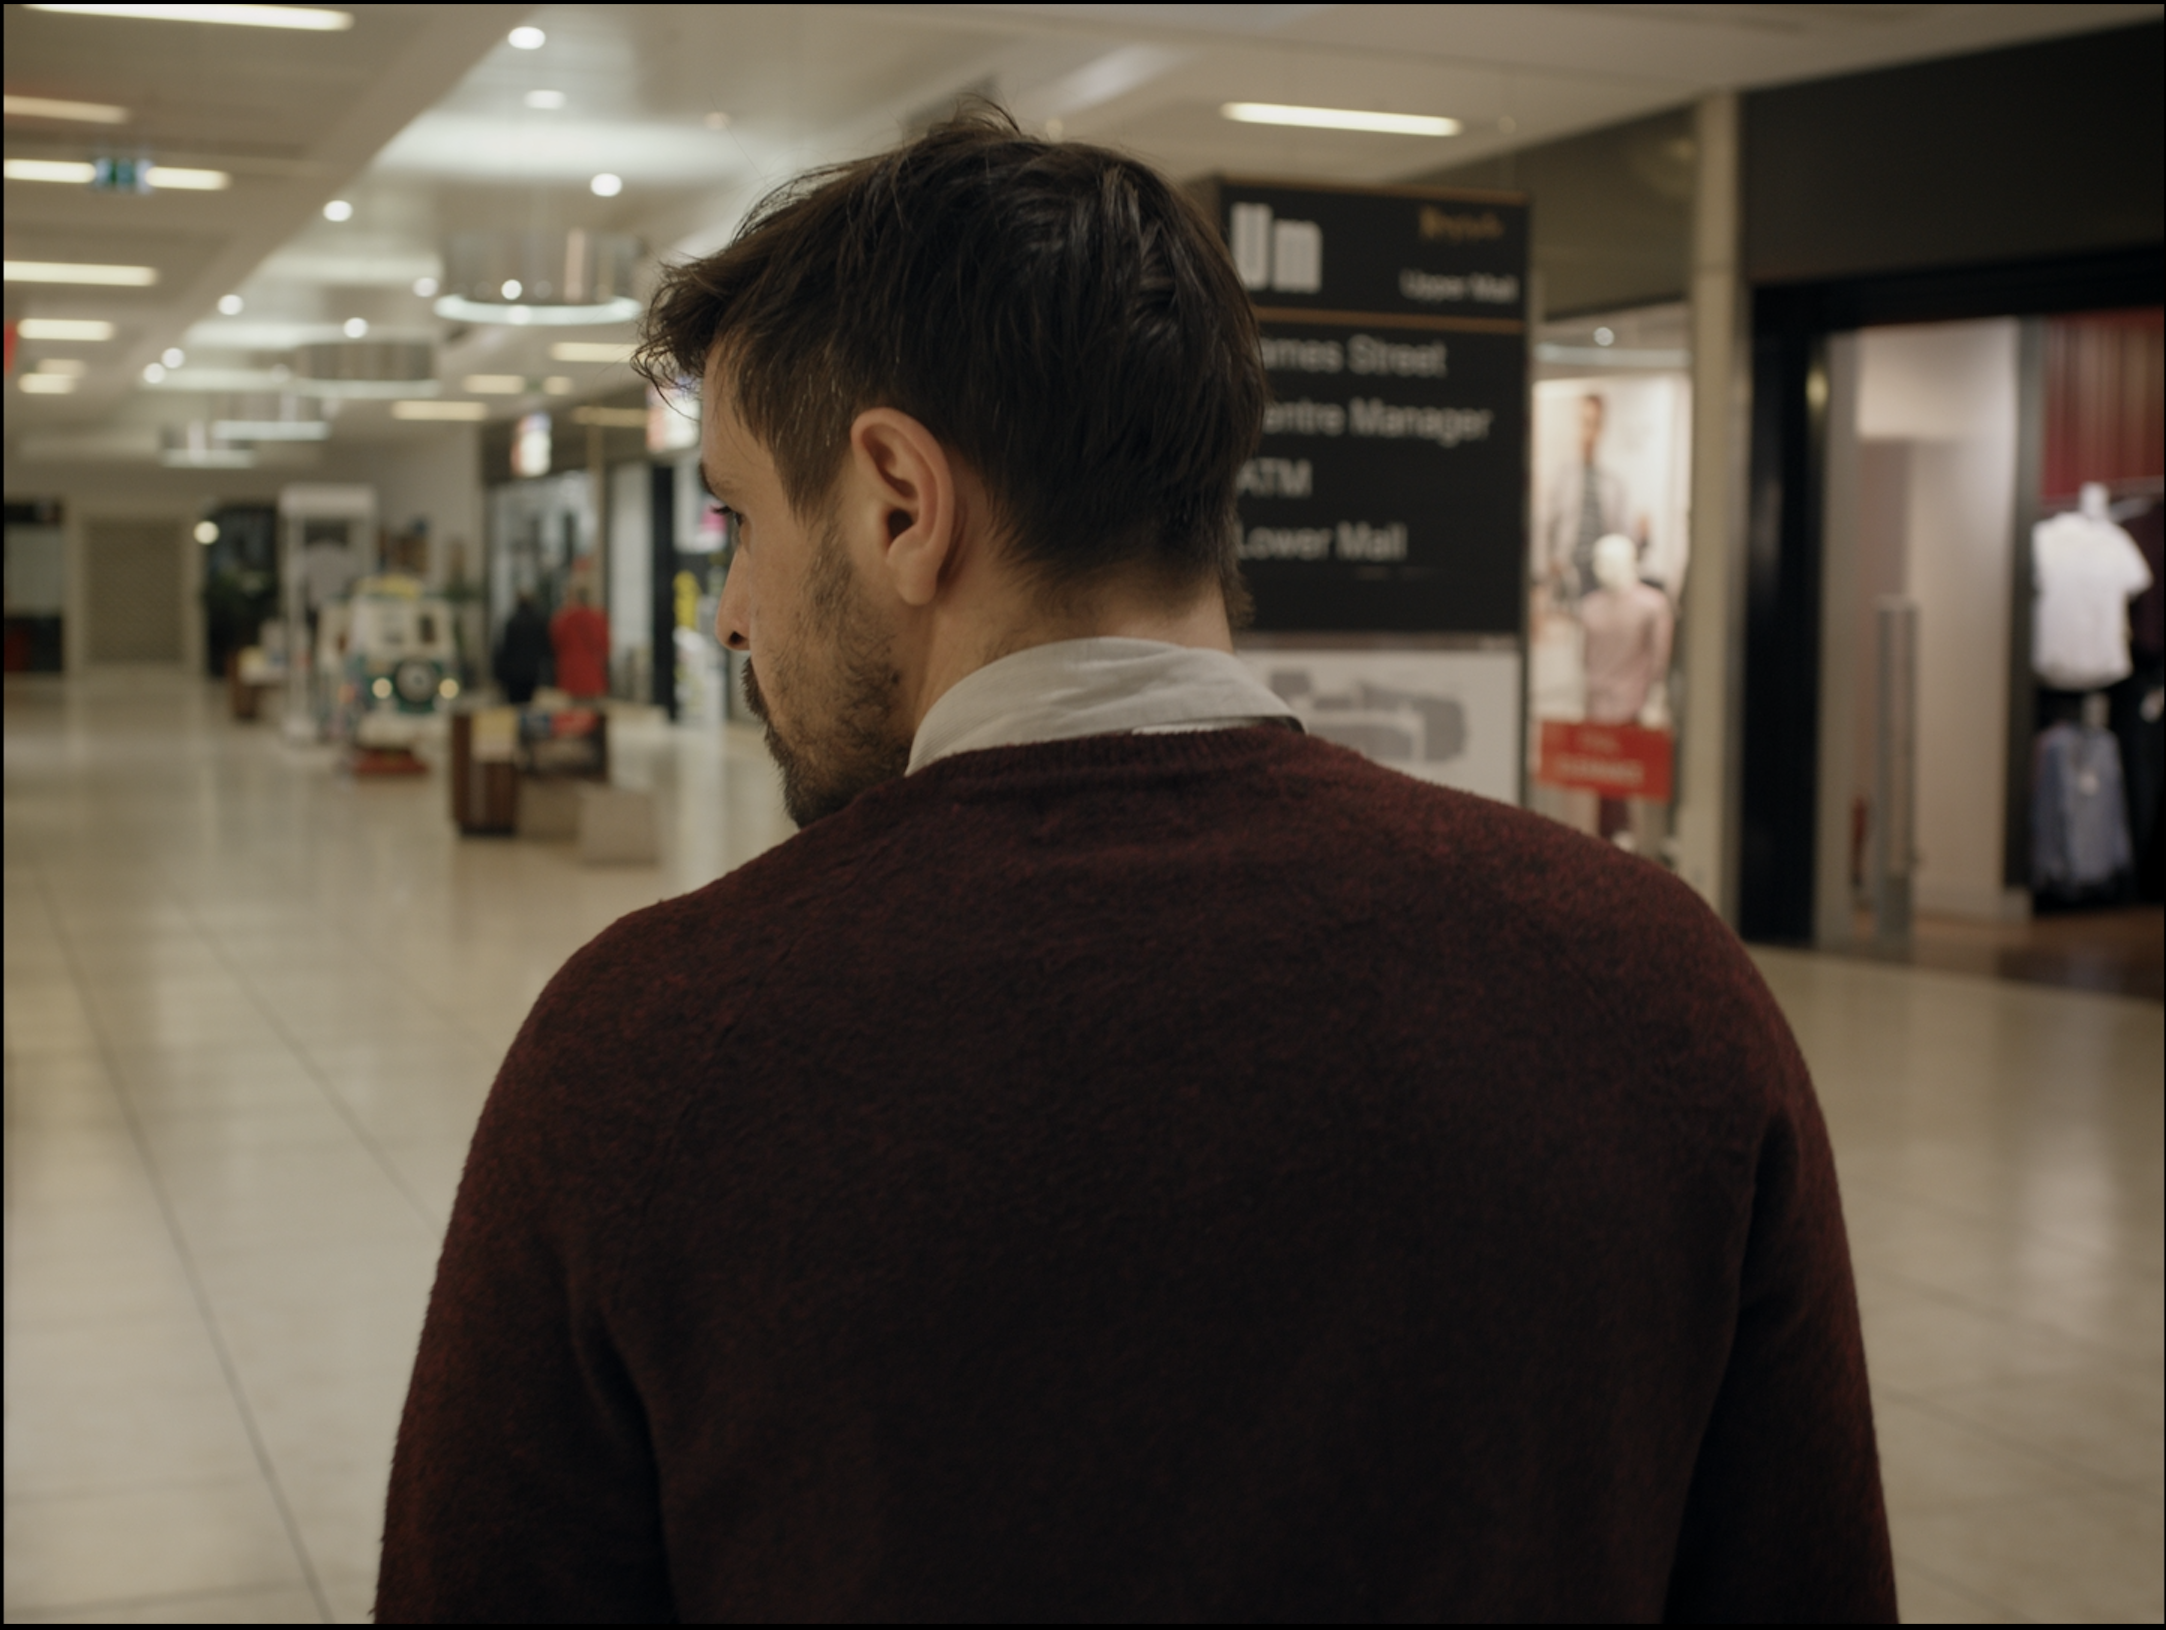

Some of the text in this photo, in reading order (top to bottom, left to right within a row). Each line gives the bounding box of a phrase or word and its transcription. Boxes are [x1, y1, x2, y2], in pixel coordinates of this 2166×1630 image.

[1469, 272, 1520, 304] Mall
[1260, 333, 1448, 378] ames Street
[1262, 397, 1494, 448] entre Manager
[1236, 457, 1312, 498] ATM
[1237, 520, 1408, 562] Lower Mall
